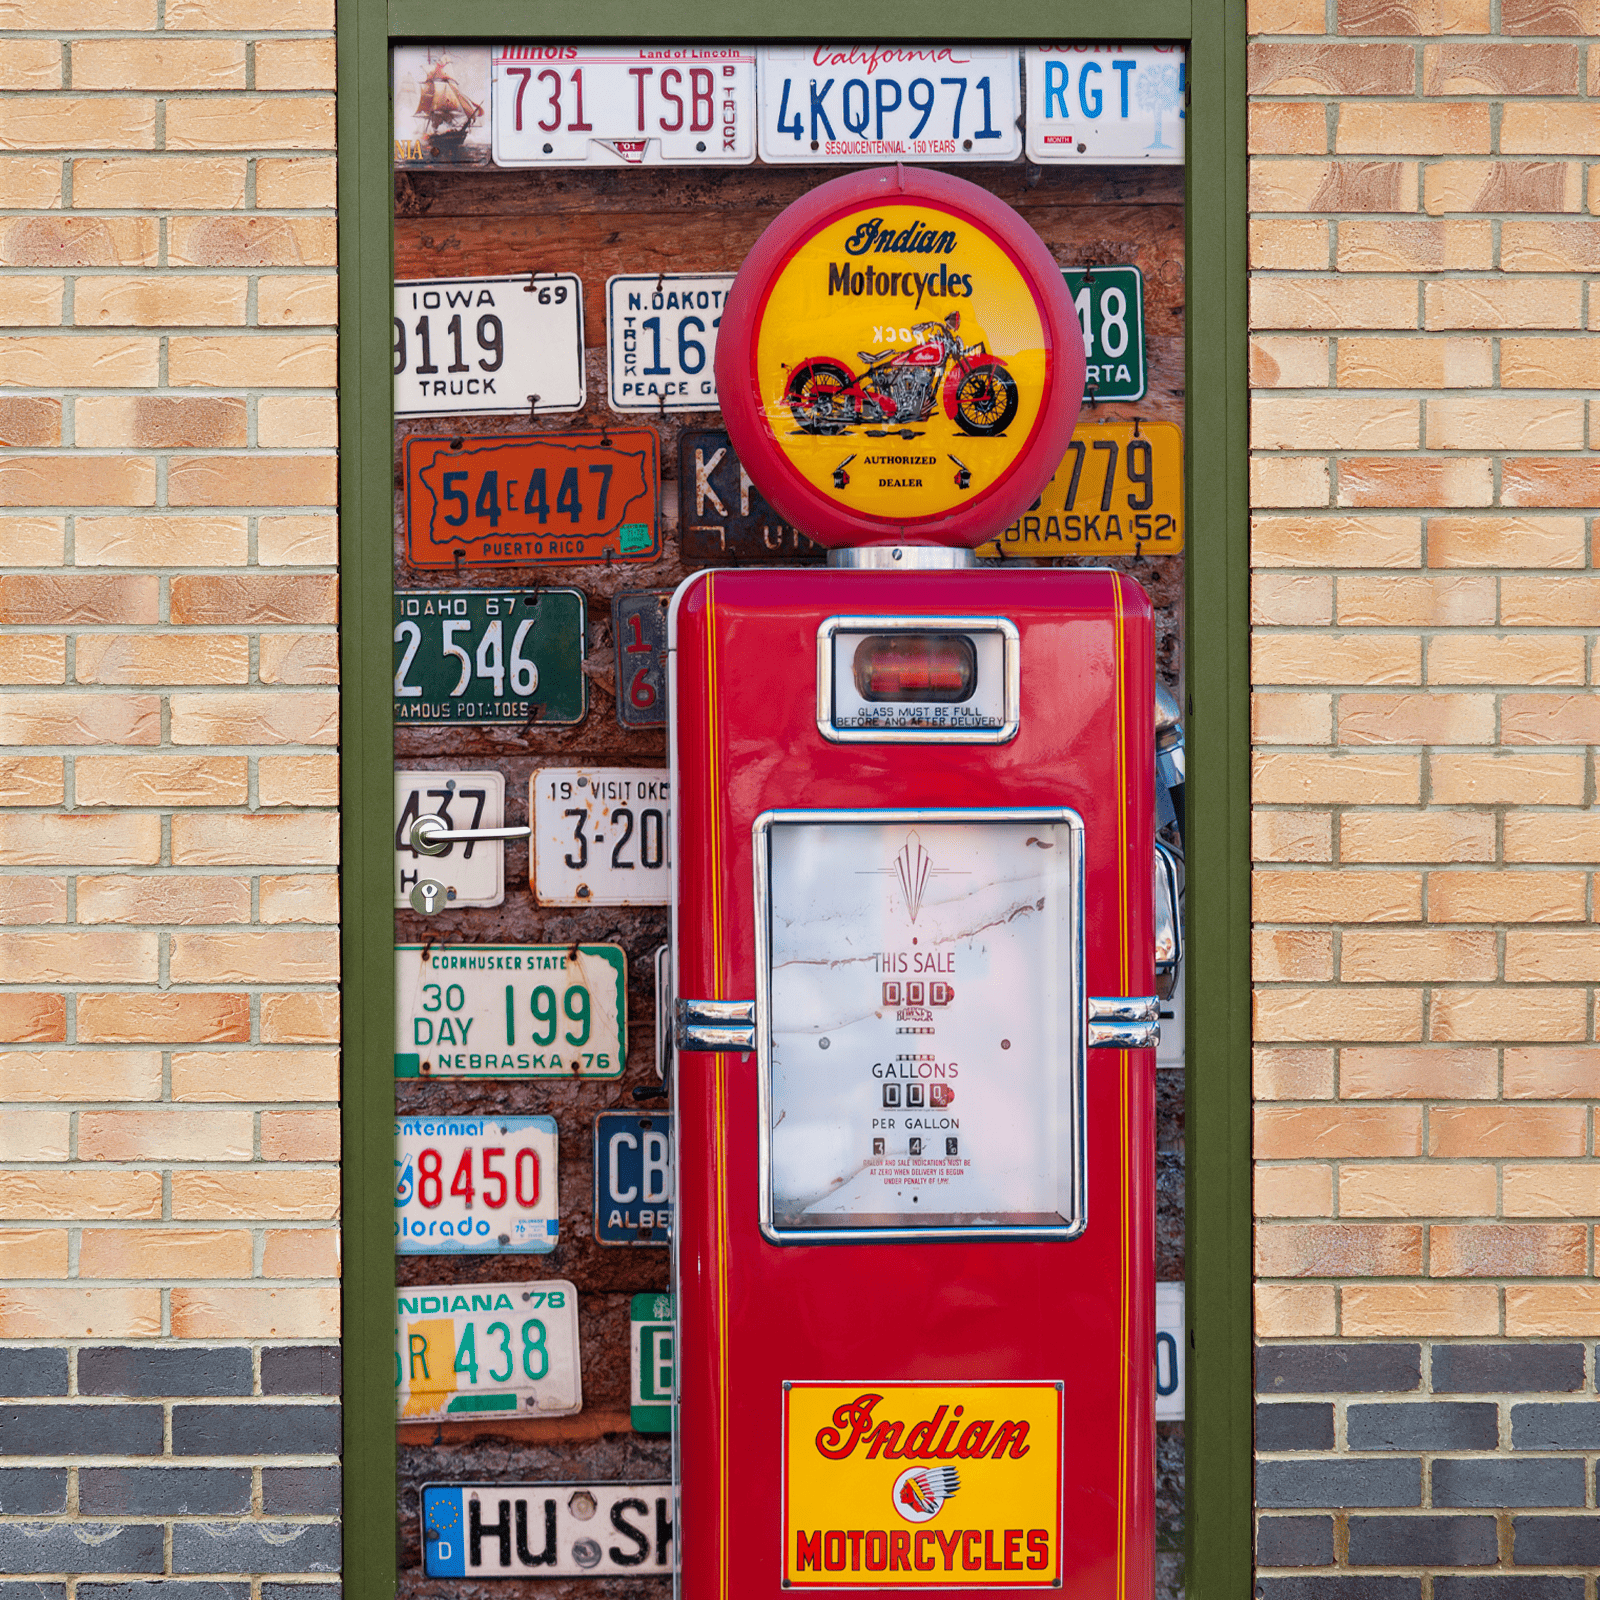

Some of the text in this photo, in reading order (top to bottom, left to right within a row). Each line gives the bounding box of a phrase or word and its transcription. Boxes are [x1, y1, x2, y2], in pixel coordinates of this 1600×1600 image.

[640, 48, 739, 58] Land of Lincoln
[812, 46, 970, 75] California
[506, 67, 715, 132] 731 TSB
[1044, 60, 1137, 119] RGT
[723, 87, 736, 151] TRUCK
[777, 76, 1002, 141] 4KQP971
[825, 140, 906, 155] SESQUICENTENNIAL
[912, 140, 927, 154] 150
[927, 139, 956, 153] YEARS
[845, 218, 957, 255] Indian
[413, 286, 568, 310] IOWA 69
[828, 262, 973, 310] Motorcycles
[1074, 286, 1129, 359] 48
[623, 316, 637, 377] TRUCK
[643, 315, 719, 375] 16
[1086, 365, 1132, 383] RTA
[419, 378, 497, 397] TRUCK
[623, 381, 718, 396] PEACE G
[864, 456, 937, 465] AUTHORIZED
[879, 479, 923, 488] DEALER
[1028, 440, 1153, 511] 779
[990, 514, 1173, 543] BRASKA 52
[483, 540, 585, 557] PUERTO RICO
[400, 598, 516, 616] IDAHO 67
[442, 619, 539, 697] 546
[836, 717, 1004, 727] BEFORE AND AFTER DELIVERY
[858, 707, 982, 717] GLASS MUST BE FULL
[551, 782, 573, 801] 19
[591, 781, 631, 800] VISIT
[395, 789, 486, 860] 437
[564, 808, 672, 870] 3-20
[432, 956, 567, 970] CORNHUSKER STATE
[873, 952, 956, 973] THIS SALE
[422, 983, 592, 1047] 30 199
[414, 1017, 474, 1046] DAY
[438, 1053, 610, 1069] NEBRASKA 76
[872, 1062, 959, 1079] GALLONS
[872, 1118, 960, 1129] PER GALLON
[608, 1131, 669, 1204] CB
[870, 1168, 877, 1176] AT
[878, 1168, 893, 1176] ZERO
[893, 1168, 910, 1176] WHEN
[911, 1168, 937, 1176] DELIVERY
[946, 1168, 964, 1176] BEGUN
[884, 1159, 896, 1167] AND
[897, 1159, 910, 1167] SALE
[912, 1159, 946, 1167] INDICATIONS
[947, 1159, 962, 1167] MUST
[963, 1159, 972, 1167] BE
[418, 1147, 541, 1210] 8450
[883, 1177, 902, 1185] UNDER
[903, 1177, 927, 1185] PENALTY
[928, 1177, 936, 1185] OF
[397, 1294, 514, 1314] NDIANA
[454, 1318, 549, 1384] 438
[815, 1393, 1031, 1460] Indian
[468, 1499, 557, 1567] HU
[438, 1541, 452, 1560] D
[796, 1529, 1049, 1571] MOTORCYCLES
